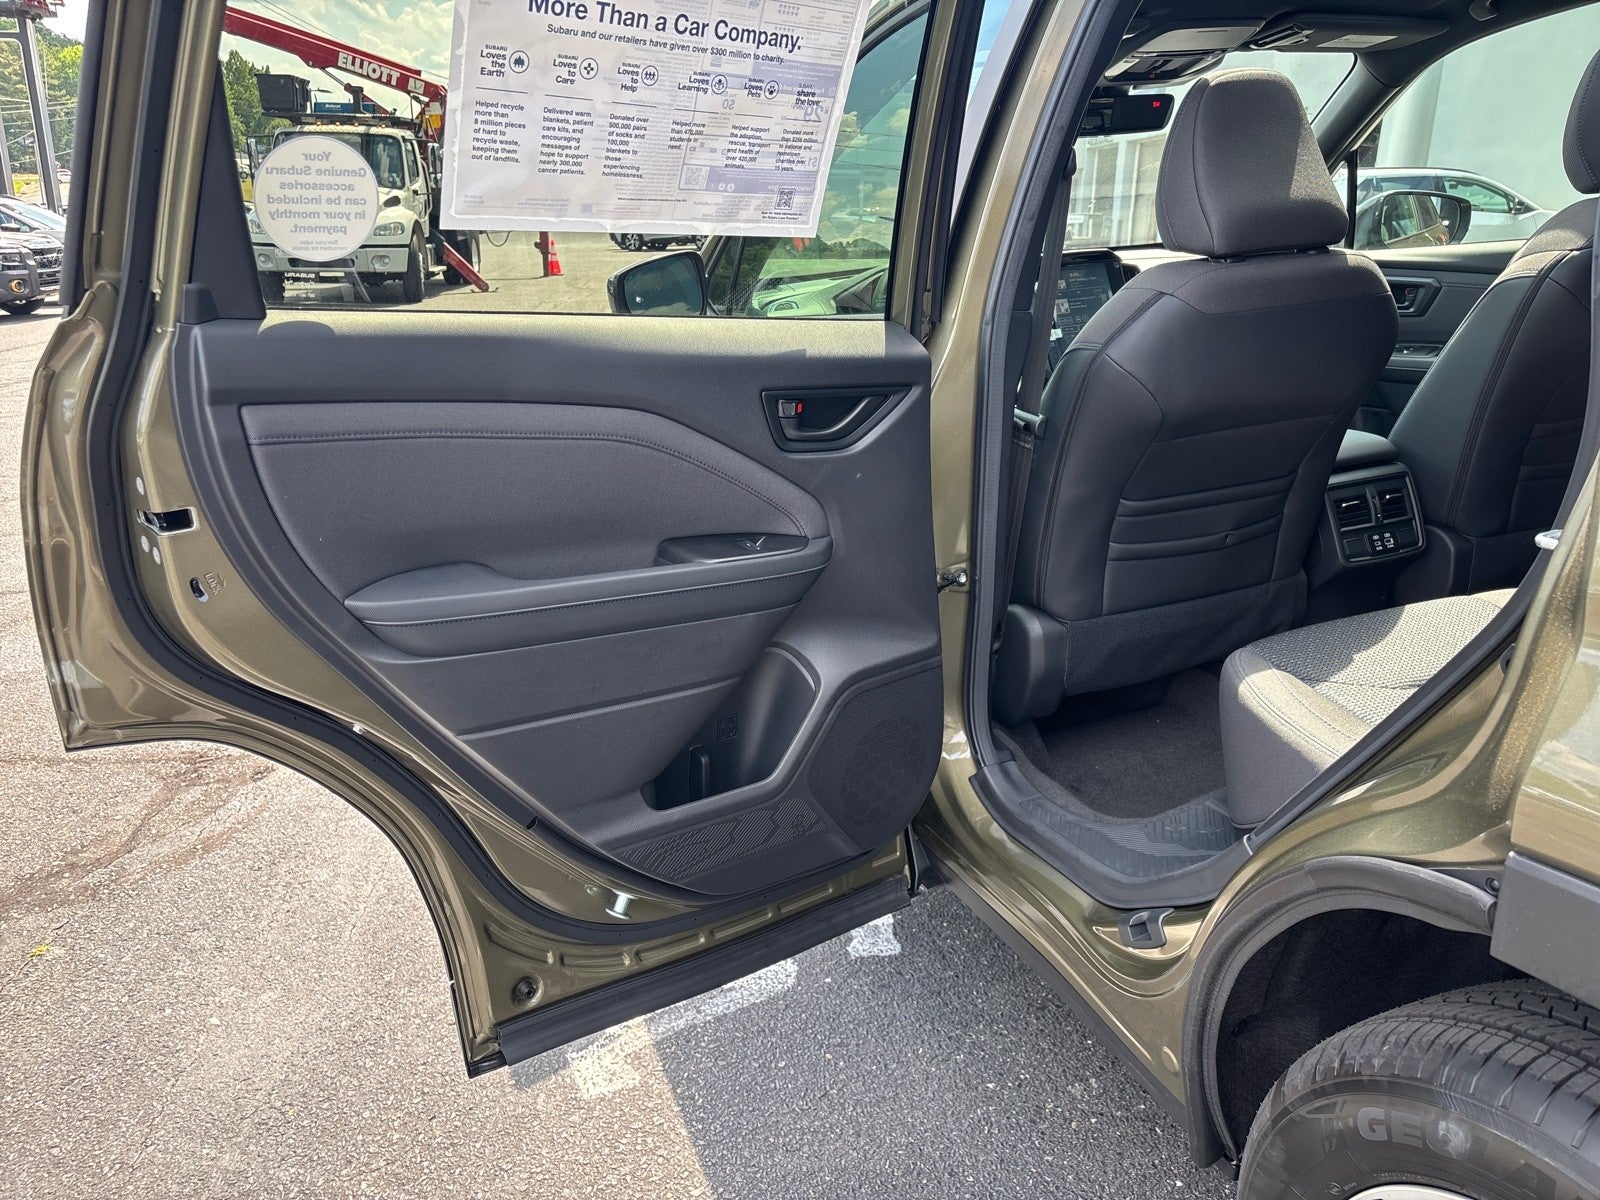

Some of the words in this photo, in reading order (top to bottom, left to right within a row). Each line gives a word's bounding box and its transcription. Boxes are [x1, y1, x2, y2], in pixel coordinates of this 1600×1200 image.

[528, 0, 588, 20] More
[597, 1, 649, 29] Than
[655, 16, 668, 32] a
[674, 13, 709, 38] Car
[714, 19, 802, 54] Company.
[547, 24, 578, 36] Subaru
[580, 30, 596, 38] and
[614, 35, 647, 46] retailers
[649, 38, 668, 48] have
[669, 42, 690, 53] given
[692, 46, 709, 54] over
[710, 47, 727, 57] $300
[728, 50, 751, 60] million
[752, 52, 760, 60] to
[761, 54, 785, 65] charity.
[480, 50, 507, 60] Loves
[491, 60, 506, 68] the
[553, 59, 577, 69] Loves
[338, 52, 400, 86] ELLIOTT
[480, 67, 505, 77] Earth
[568, 69, 576, 77] to
[617, 67, 639, 76] Loves
[555, 76, 575, 84] Care
[689, 76, 709, 85] Loves
[621, 84, 637, 93] Help
[678, 83, 708, 94] Learning
[744, 83, 762, 91] Loves
[747, 90, 761, 98] Pets
[797, 89, 816, 98] share
[475, 100, 498, 108] Helped
[501, 102, 524, 111] recycle
[795, 97, 806, 105] the
[807, 98, 820, 106] love
[544, 107, 573, 116] Delivered
[480, 119, 503, 127] million
[505, 121, 526, 129] pieces
[543, 116, 571, 125] blankets,
[482, 128, 498, 136] hard
[558, 126, 570, 134] kits,
[473, 137, 497, 145] recycle
[542, 135, 580, 143] encouraging
[472, 145, 499, 154] keeping
[541, 143, 572, 151] messages
[493, 155, 520, 163] landfills.
[603, 164, 640, 172] experiencing
[602, 171, 644, 179] homelessness.
